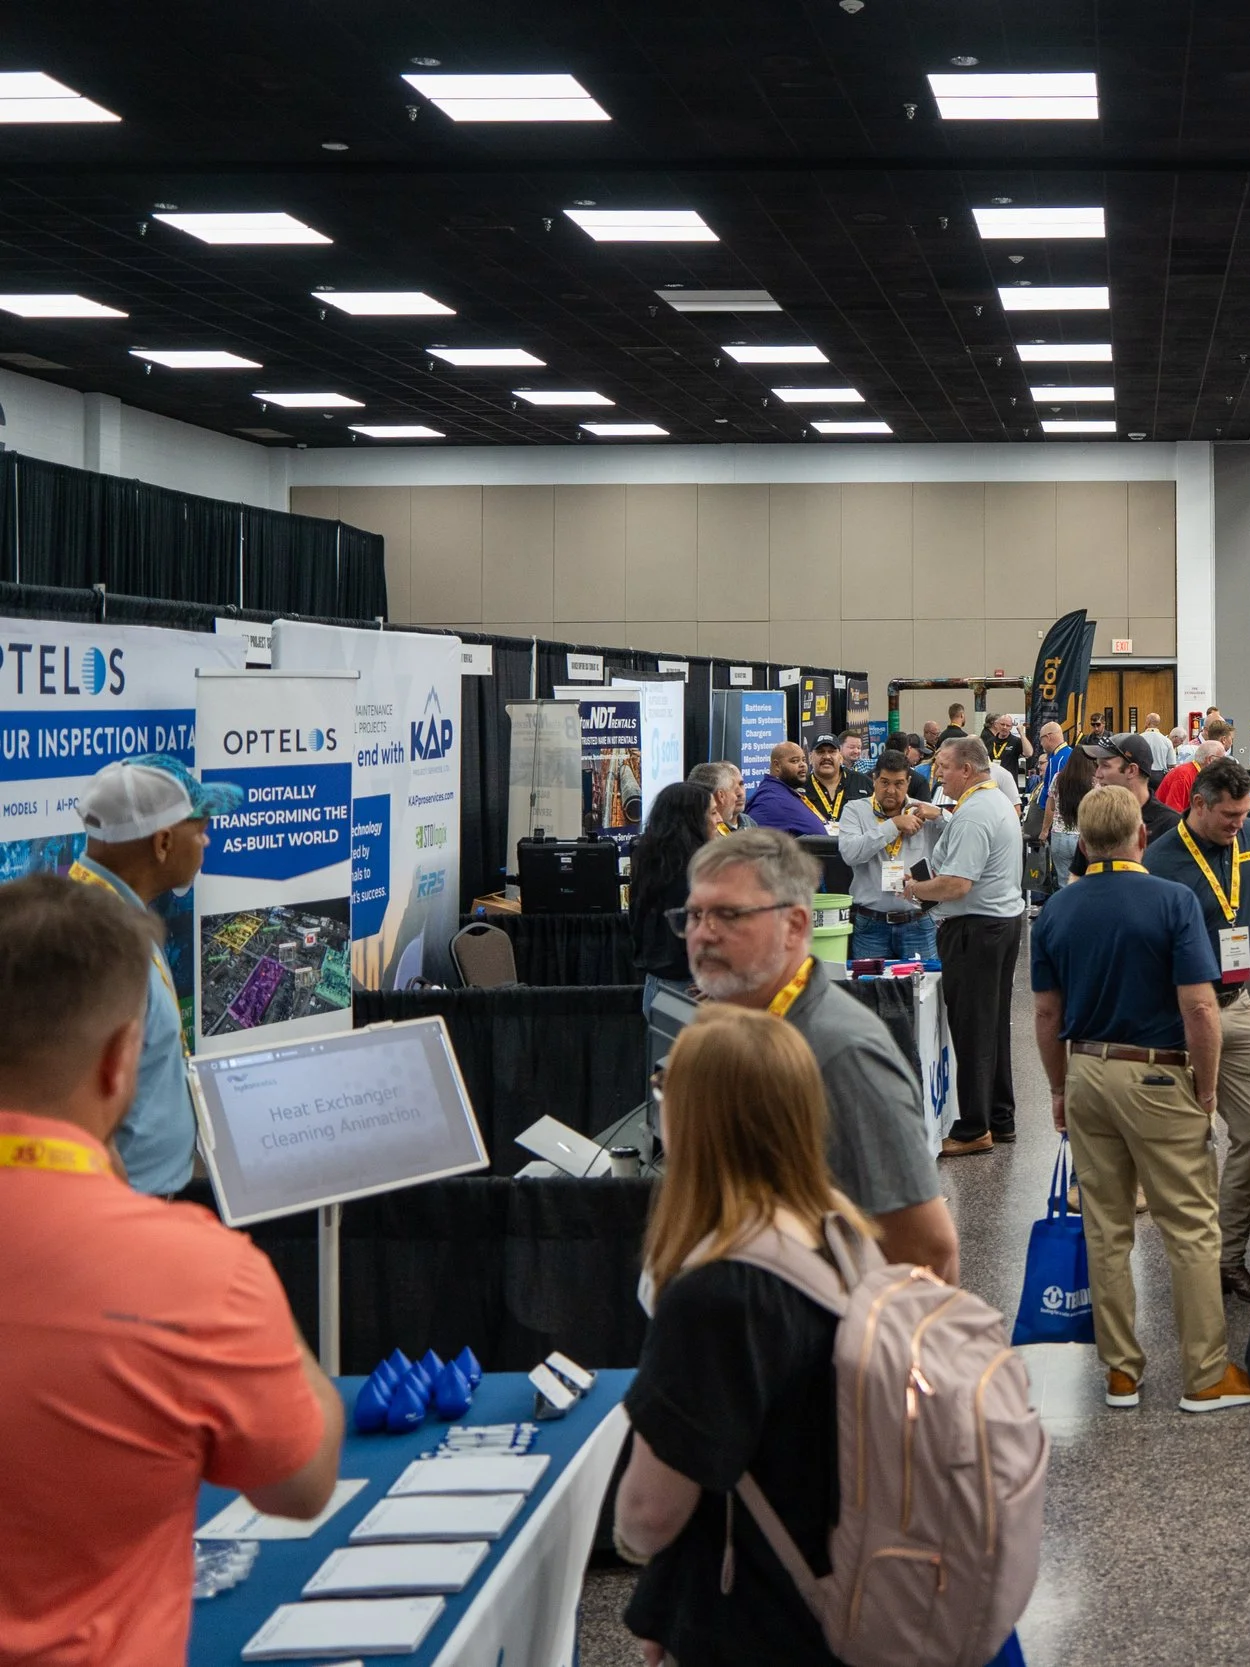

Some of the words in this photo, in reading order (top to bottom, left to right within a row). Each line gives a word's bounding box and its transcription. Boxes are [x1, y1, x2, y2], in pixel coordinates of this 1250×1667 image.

[1115, 641, 1129, 651] EXIT
[0, 643, 125, 696] TELOS
[1039, 656, 1062, 700] top
[745, 703, 772, 712] Batteries
[590, 706, 616, 729] NDT
[611, 718, 637, 729] RENTALS
[758, 716, 782, 726] Systems
[359, 721, 387, 734] PROJECTS
[745, 730, 772, 739] Chargers
[38, 726, 148, 758] INSPECTION
[224, 728, 337, 755] OPTELOS
[410, 713, 453, 762] KAP
[618, 735, 638, 745] RENTALS
[357, 742, 379, 767] end
[381, 740, 404, 764] with
[248, 785, 317, 803] DIGITALLY
[408, 791, 454, 807] KAPproservices.com
[4, 802, 38, 816] MODELS
[211, 807, 321, 829] TRANSFORMING
[324, 805, 348, 819] THE
[351, 822, 383, 838] echnology
[223, 834, 285, 853] AS-BUILT
[288, 828, 339, 847] WORLD
[361, 845, 370, 861] by
[363, 868, 371, 880] to
[361, 885, 387, 902] success.
[269, 1102, 310, 1123] Heat
[315, 1084, 400, 1115] Exchanger
[261, 1123, 336, 1152] Cleaning
[340, 1106, 421, 1134] Animation
